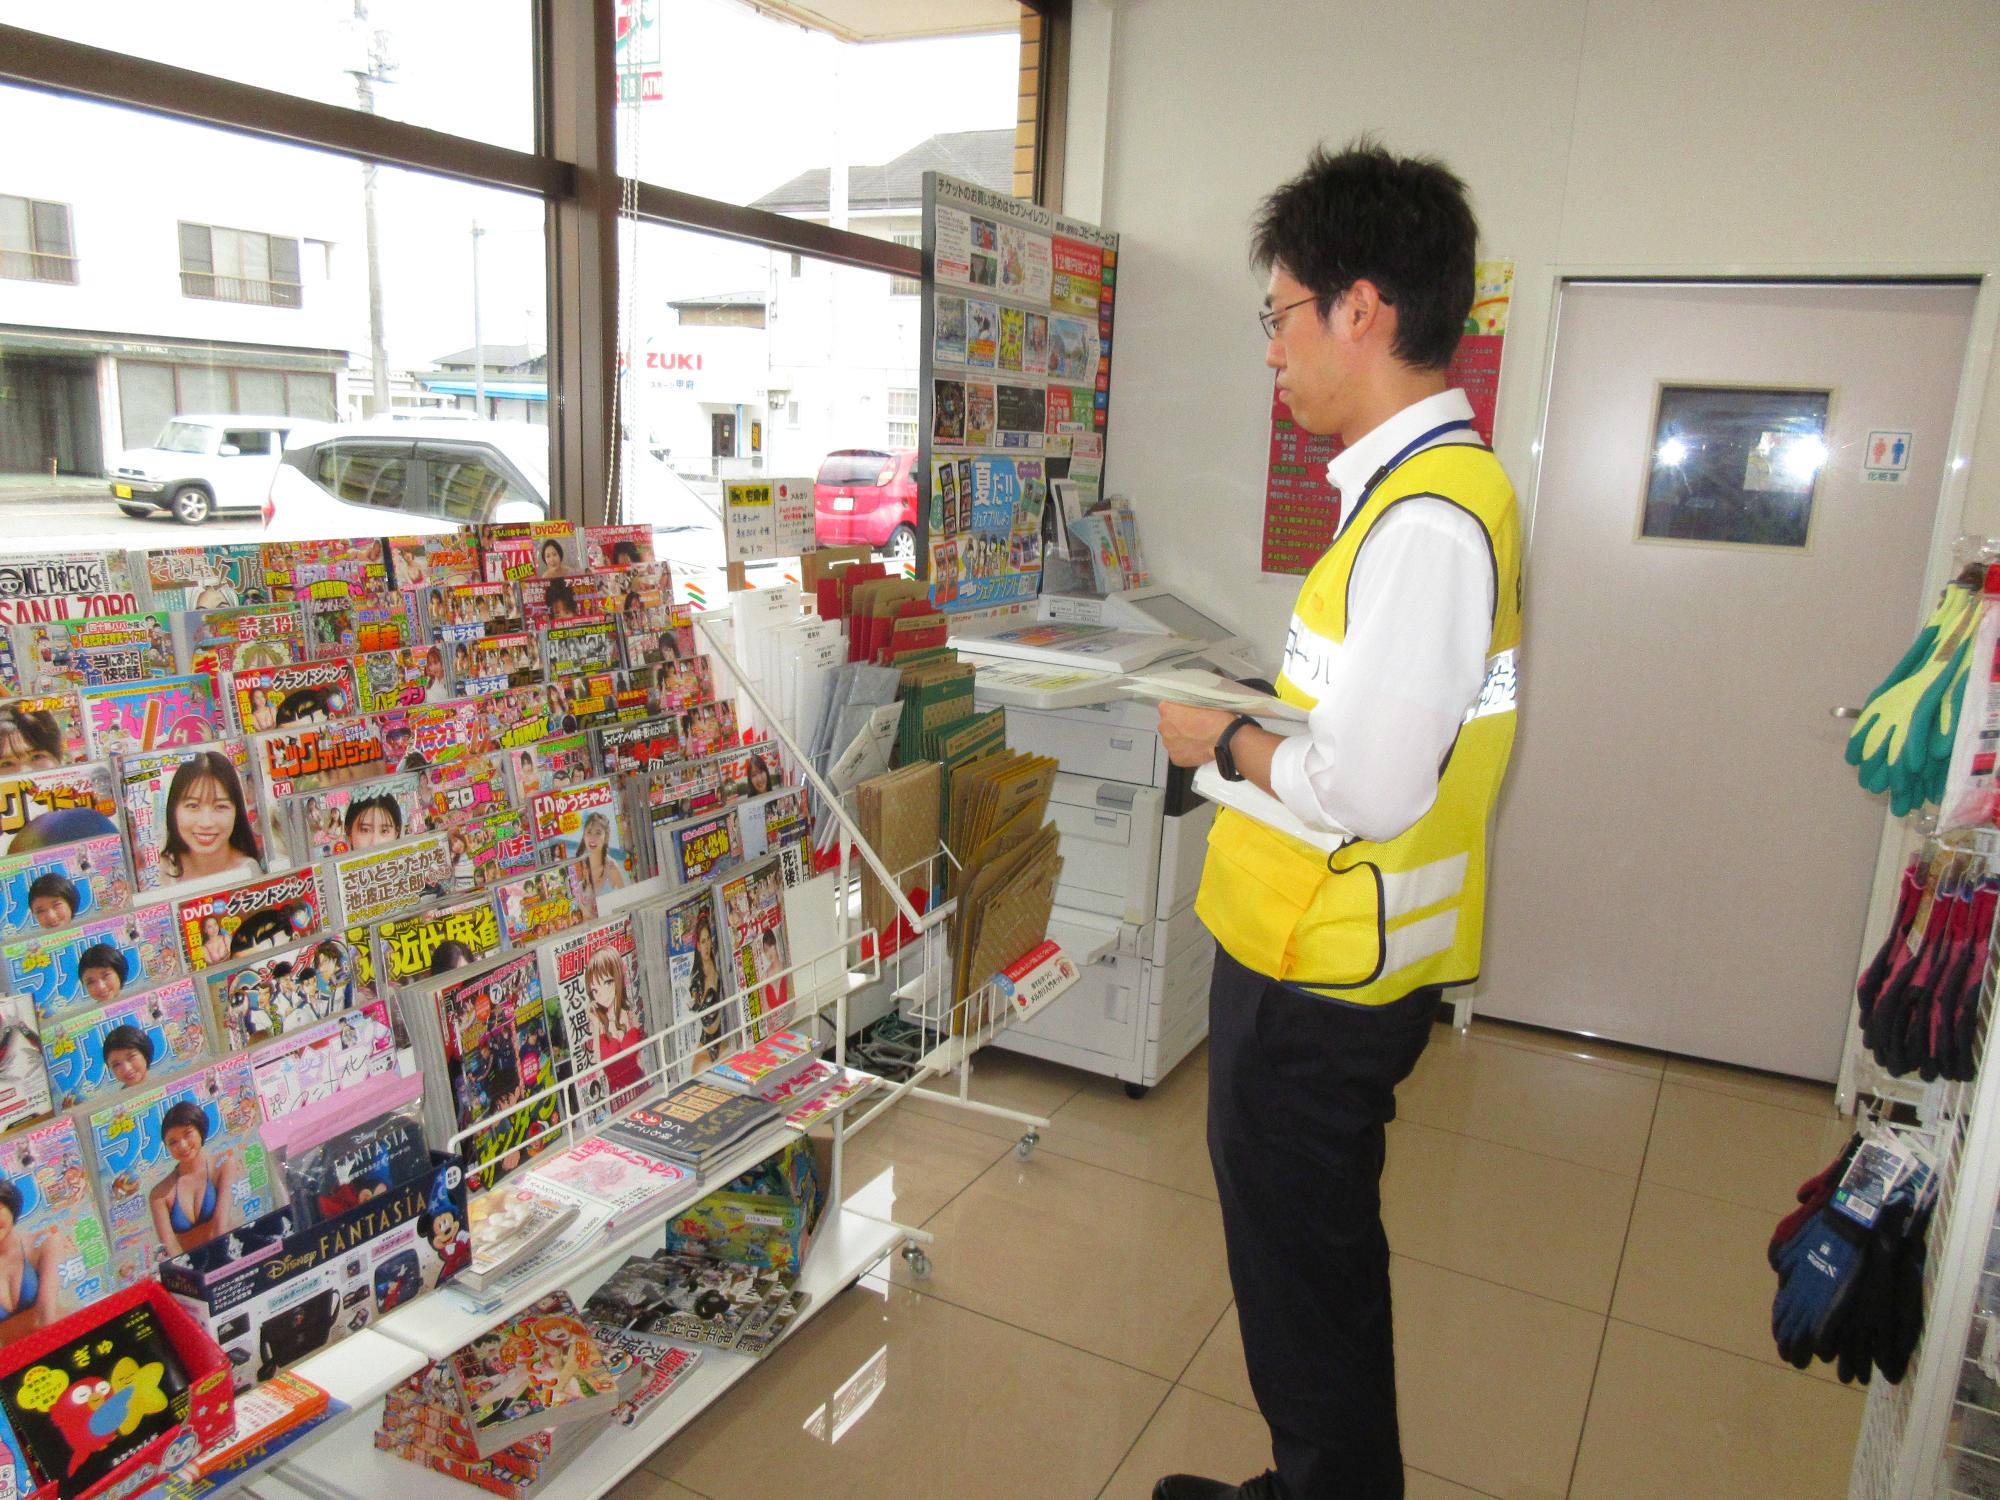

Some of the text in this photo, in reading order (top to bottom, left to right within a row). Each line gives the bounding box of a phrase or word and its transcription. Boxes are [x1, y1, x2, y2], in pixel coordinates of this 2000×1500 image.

[642, 79, 662, 97] ATM
[506, 564, 534, 580] DELUXE
[235, 678, 260, 690] DVD
[272, 665, 350, 691] グランドジャンプ
[555, 787, 612, 817] ゆうちゃみ
[343, 848, 447, 891] さいとう・たかを
[227, 876, 316, 916] グランドジャンプ
[346, 875, 426, 911] 池波正太郎
[183, 904, 213, 921] DVD
[389, 904, 500, 977] 近代麻雀
[333, 1127, 409, 1172] FANTASIA
[320, 1191, 427, 1259] FANTASIA
[654, 1317, 734, 1346] 鬼平犯科帳
